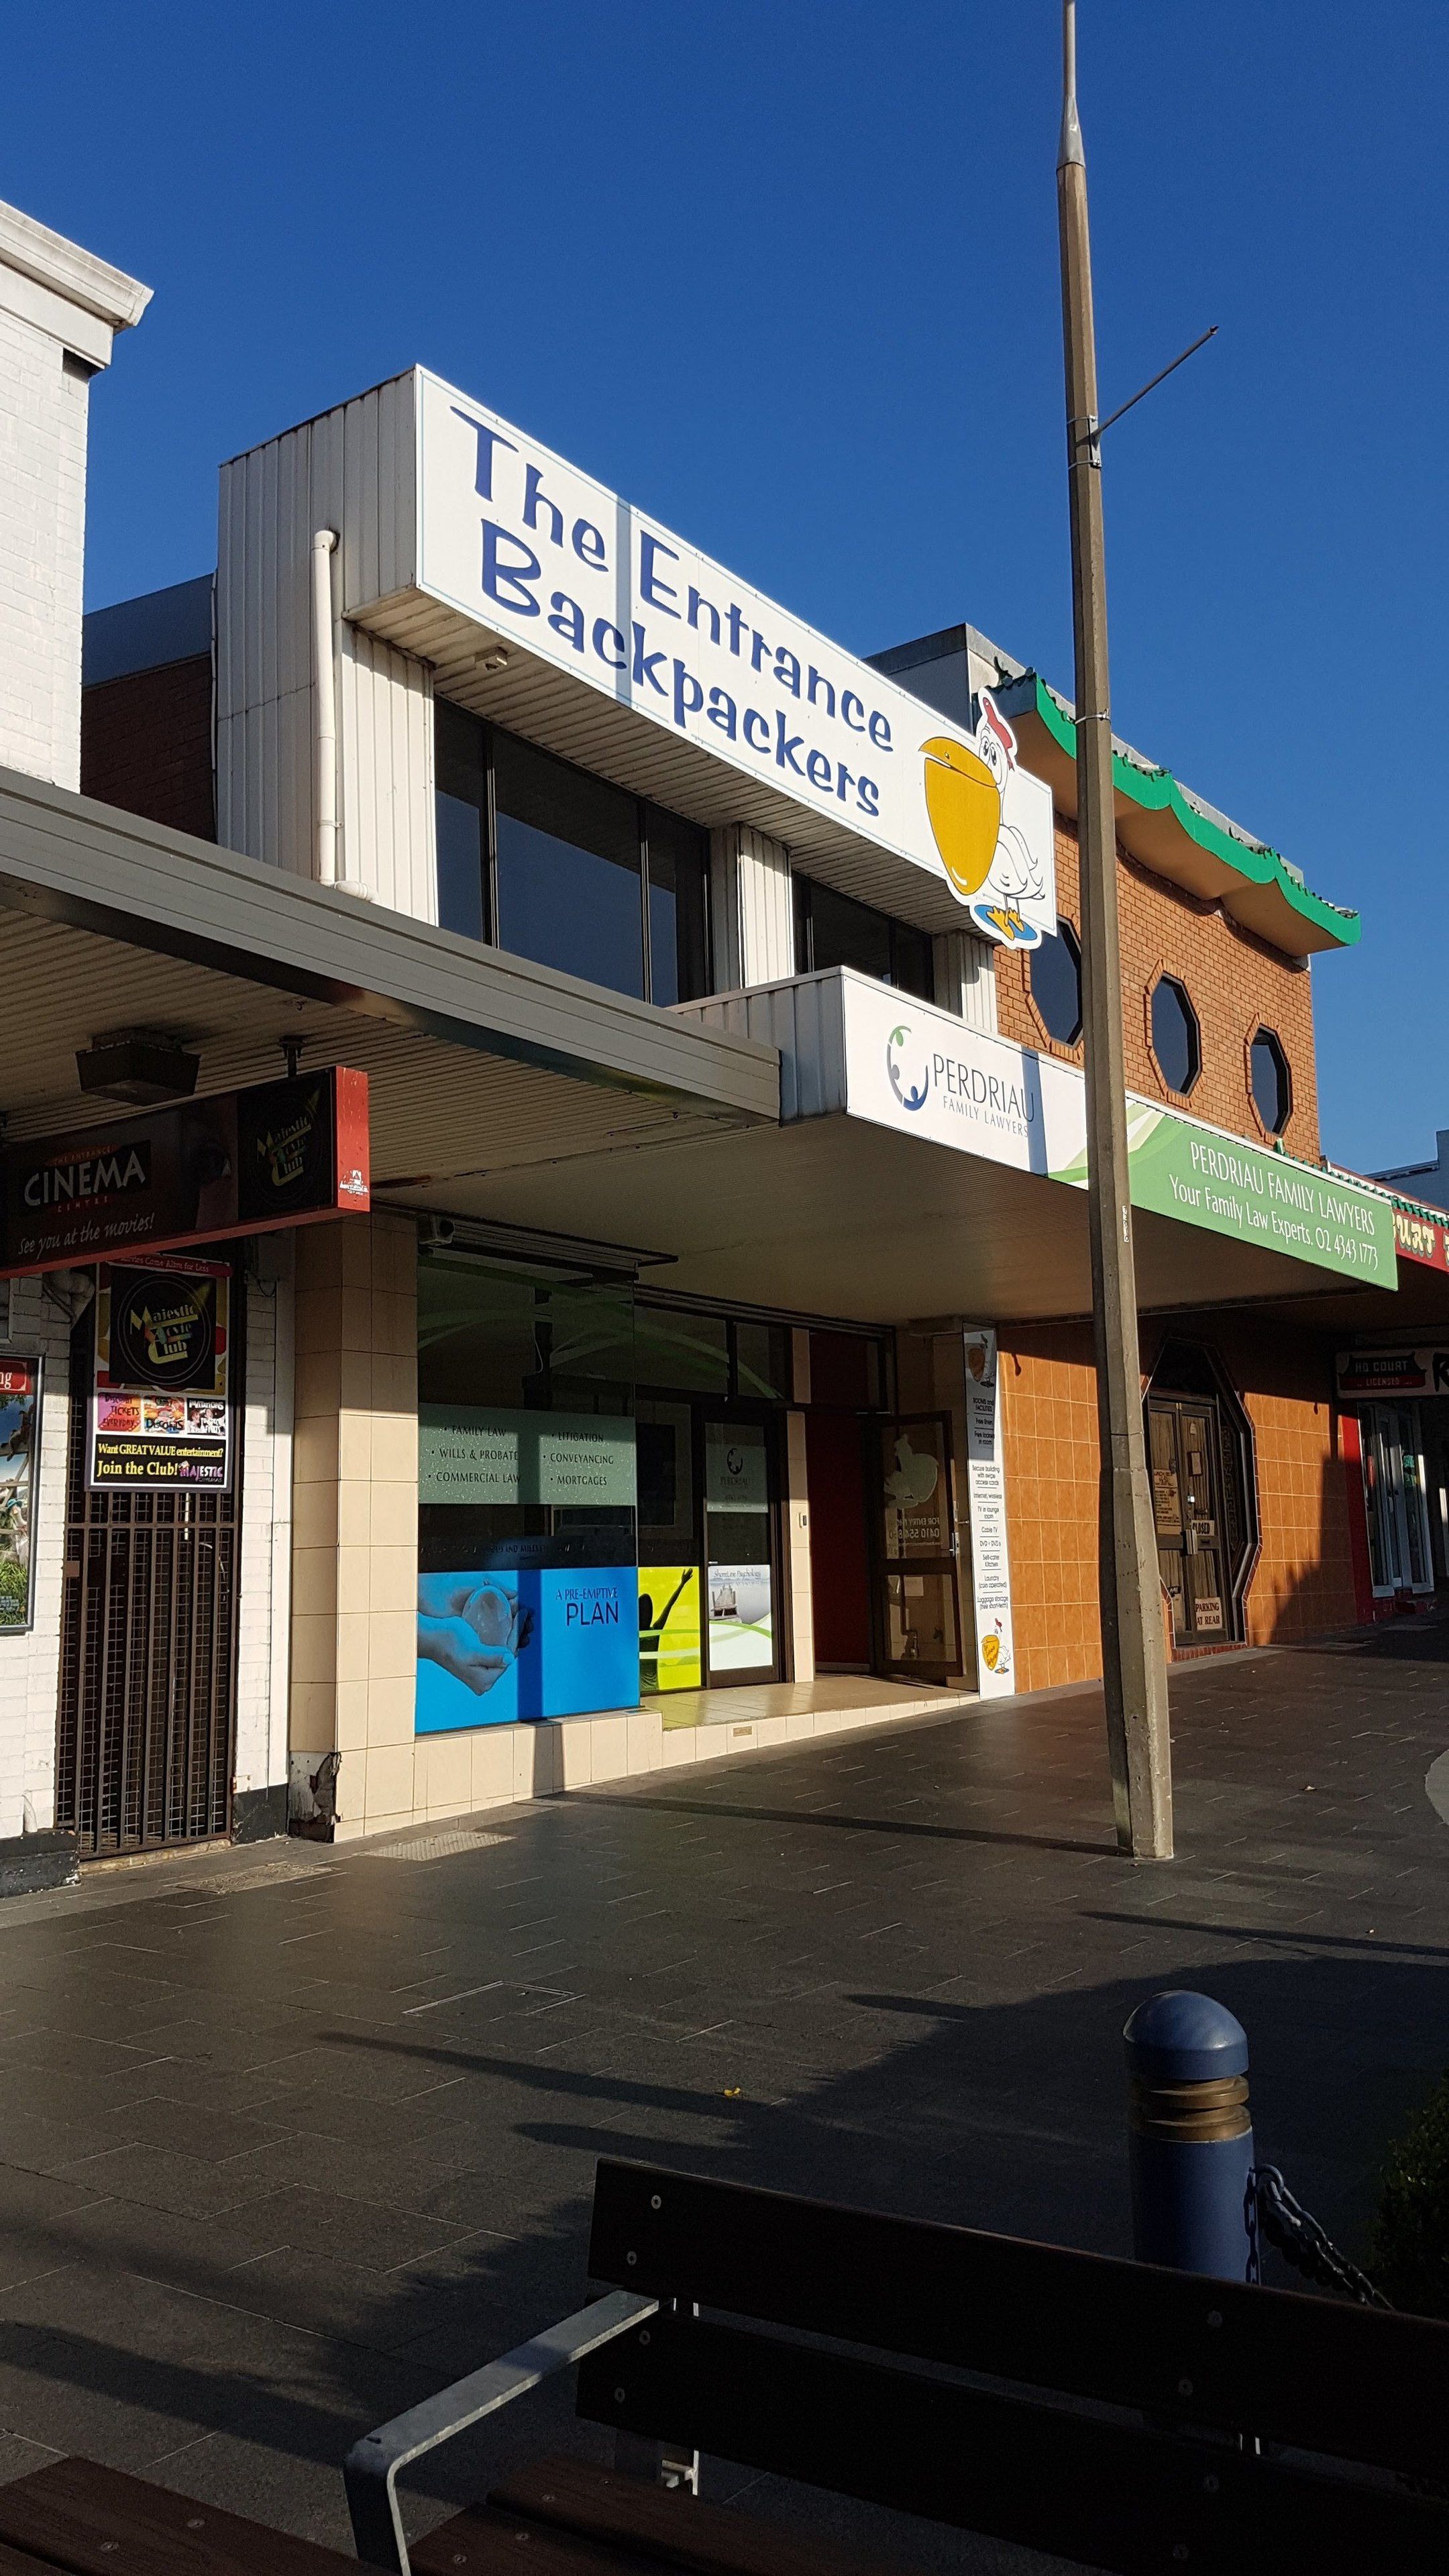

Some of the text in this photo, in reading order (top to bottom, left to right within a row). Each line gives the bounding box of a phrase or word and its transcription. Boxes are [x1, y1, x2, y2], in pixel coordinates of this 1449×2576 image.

[451, 405, 894, 754] The Entrance
[480, 517, 880, 818] Backpackers
[933, 1053, 1034, 1122] PERDRIAU
[943, 1095, 1028, 1138] FAMILY LAWYERS
[24, 1150, 146, 1206] CINEMA
[1190, 1141, 1375, 1236] PERDRIAU FAMILY LAWYERS
[1169, 1174, 1201, 1207] Your
[1205, 1187, 1242, 1229] Family
[1246, 1201, 1268, 1230] Law
[1271, 1210, 1313, 1244] Experts.
[1334, 1234, 1356, 1264] 4343
[1359, 1243, 1378, 1271] 1773
[18, 1212, 156, 1260] See you at the movies!
[1392, 1213, 1435, 1256] URT
[130, 1304, 199, 1335] Majestic
[148, 1340, 188, 1364] Club
[1373, 1360, 1408, 1372] COURT
[111, 1405, 140, 1416] TICKETS
[451, 1425, 506, 1437] FAMILY LAW
[557, 1431, 604, 1442] LITIGATION
[98, 1443, 223, 1458] Want GREAT VALUE entertainment?
[439, 1448, 521, 1461] WILLS & PROBATE
[550, 1452, 614, 1464] CONVEYANCING
[97, 1460, 177, 1477] Join the Club!
[179, 1465, 223, 1481] MAJESTIC
[436, 1472, 521, 1484] COMMERCIAL LAW
[557, 1475, 607, 1486] MORTGAGES
[1192, 1522, 1210, 1535] CLOSED
[555, 1587, 618, 1601] A PRE-EMPTIVE
[567, 1601, 619, 1626] PLAN
[1195, 1602, 1220, 1612] PARKING
[1197, 1615, 1220, 1625] AT REAR
